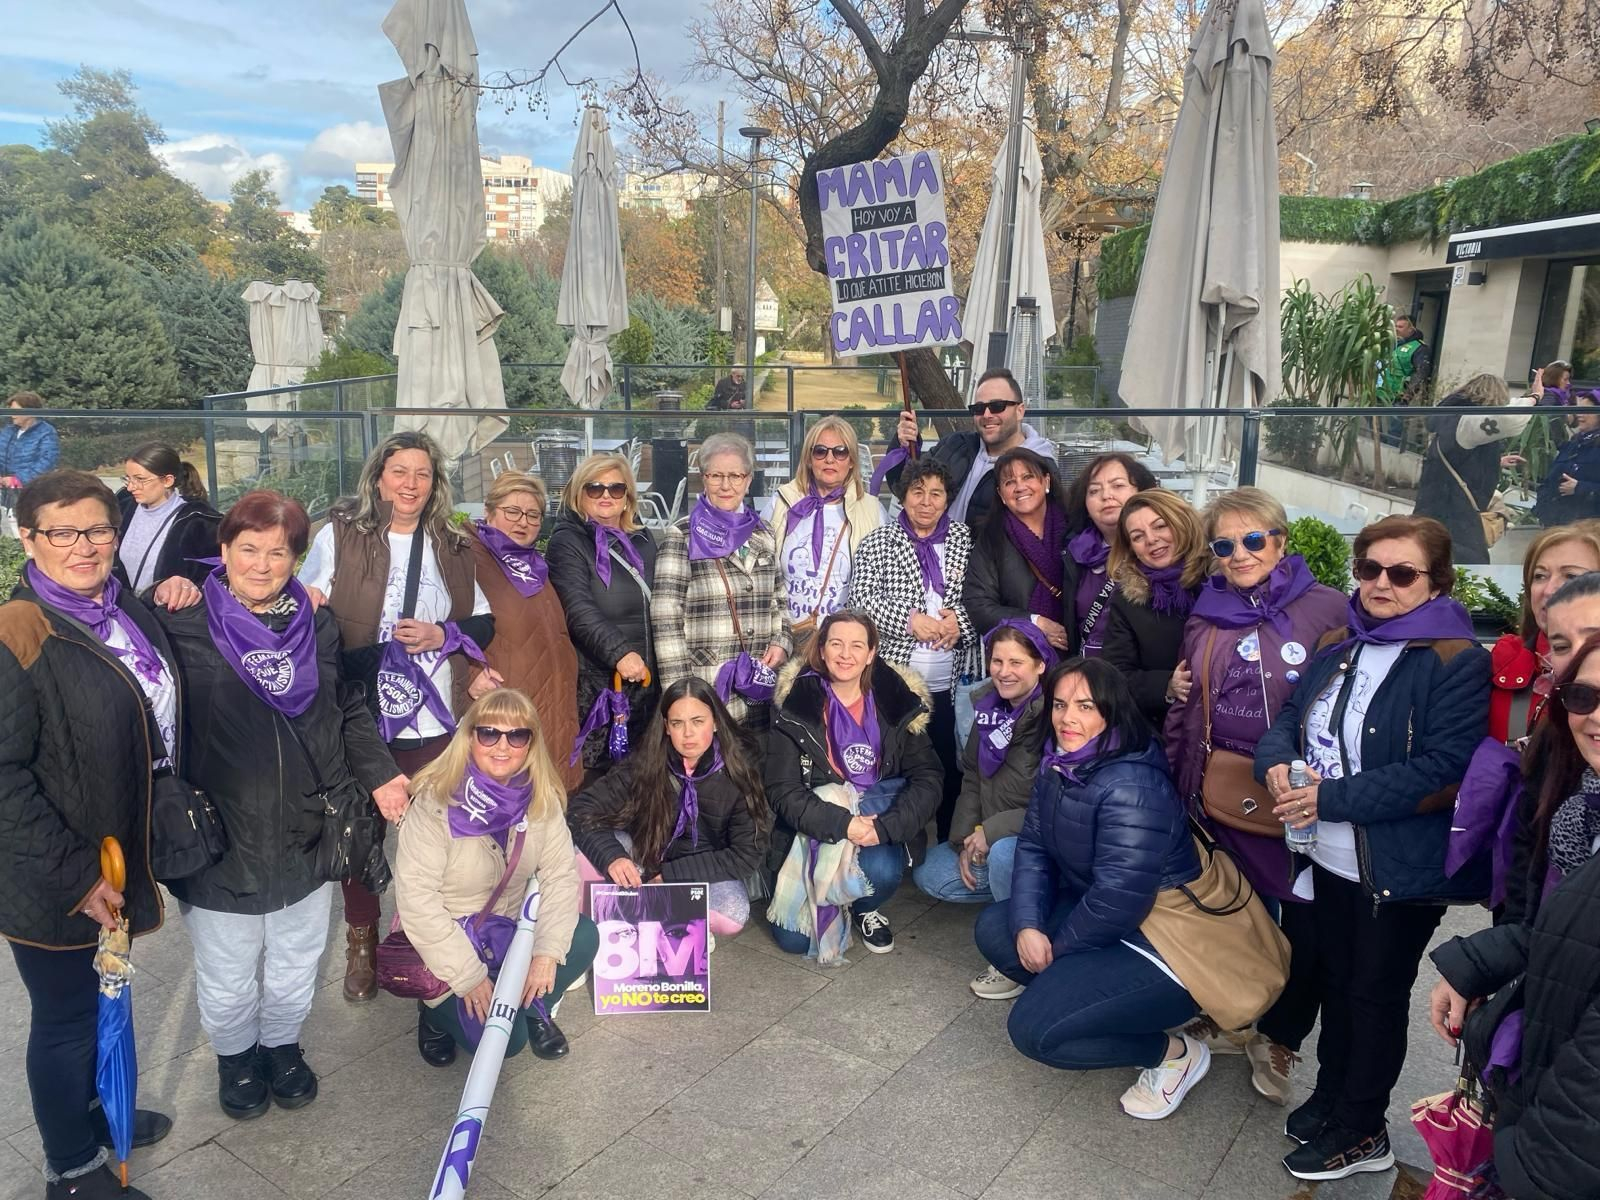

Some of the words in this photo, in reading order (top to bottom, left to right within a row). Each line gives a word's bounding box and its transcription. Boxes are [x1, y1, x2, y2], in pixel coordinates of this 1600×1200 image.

[818, 151, 939, 211] MAMA
[853, 210, 876, 226] HOY
[878, 207, 901, 224] VOY
[903, 207, 914, 220] A
[824, 221, 949, 279] GRITAR
[1456, 241, 1481, 256] VICTORIA
[837, 283, 849, 300] LO
[851, 281, 867, 299] QUE
[905, 271, 944, 289] HICIERON
[831, 296, 962, 352] CALLAR
[788, 579, 837, 599] Librs
[1084, 601, 1103, 633] BIMBA
[381, 682, 407, 704] PSOE
[593, 919, 707, 980] 8M
[613, 983, 660, 992] Moreno
[661, 981, 705, 993] Bonilla,
[600, 995, 620, 1009] yo
[622, 992, 652, 1006] NO
[653, 993, 669, 1003] te
[670, 993, 705, 1004] creo
